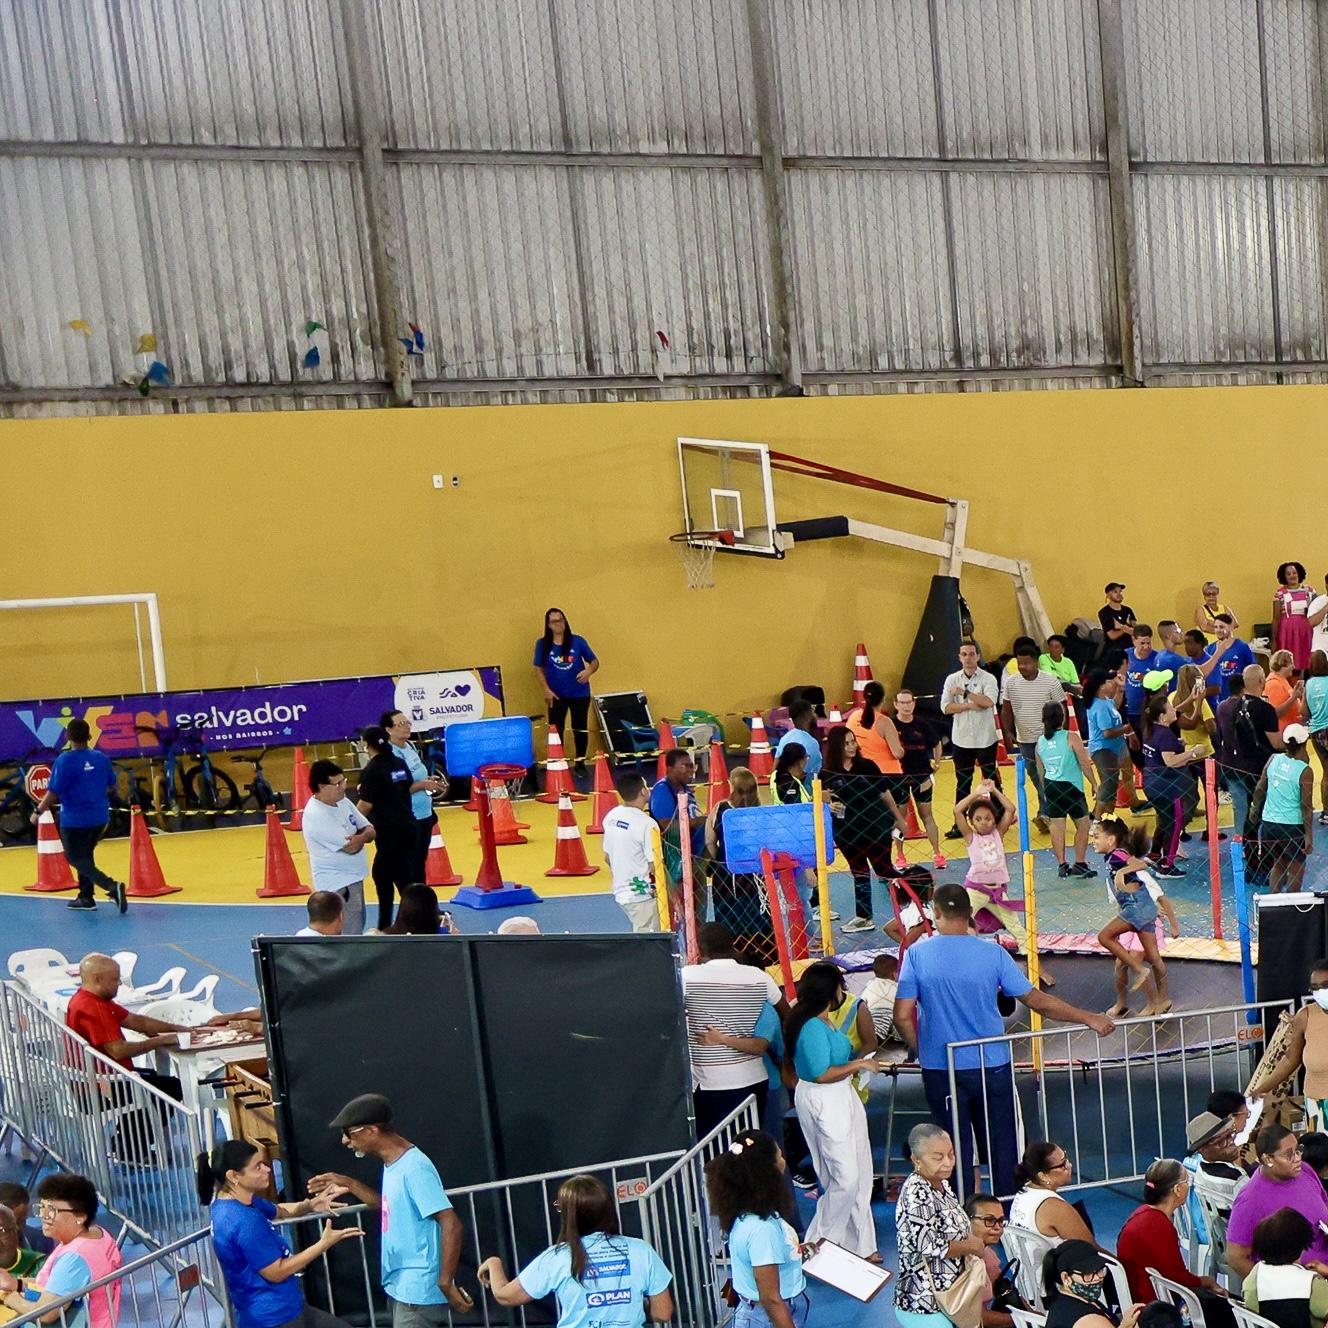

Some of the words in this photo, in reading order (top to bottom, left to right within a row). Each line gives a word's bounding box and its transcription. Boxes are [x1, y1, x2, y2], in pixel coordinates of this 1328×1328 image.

[429, 704, 474, 714] SALVADOR
[176, 702, 307, 732] salvador
[31, 778, 50, 791] PAR
[617, 1181, 647, 1198] ELO
[606, 1291, 631, 1301] PLAN
